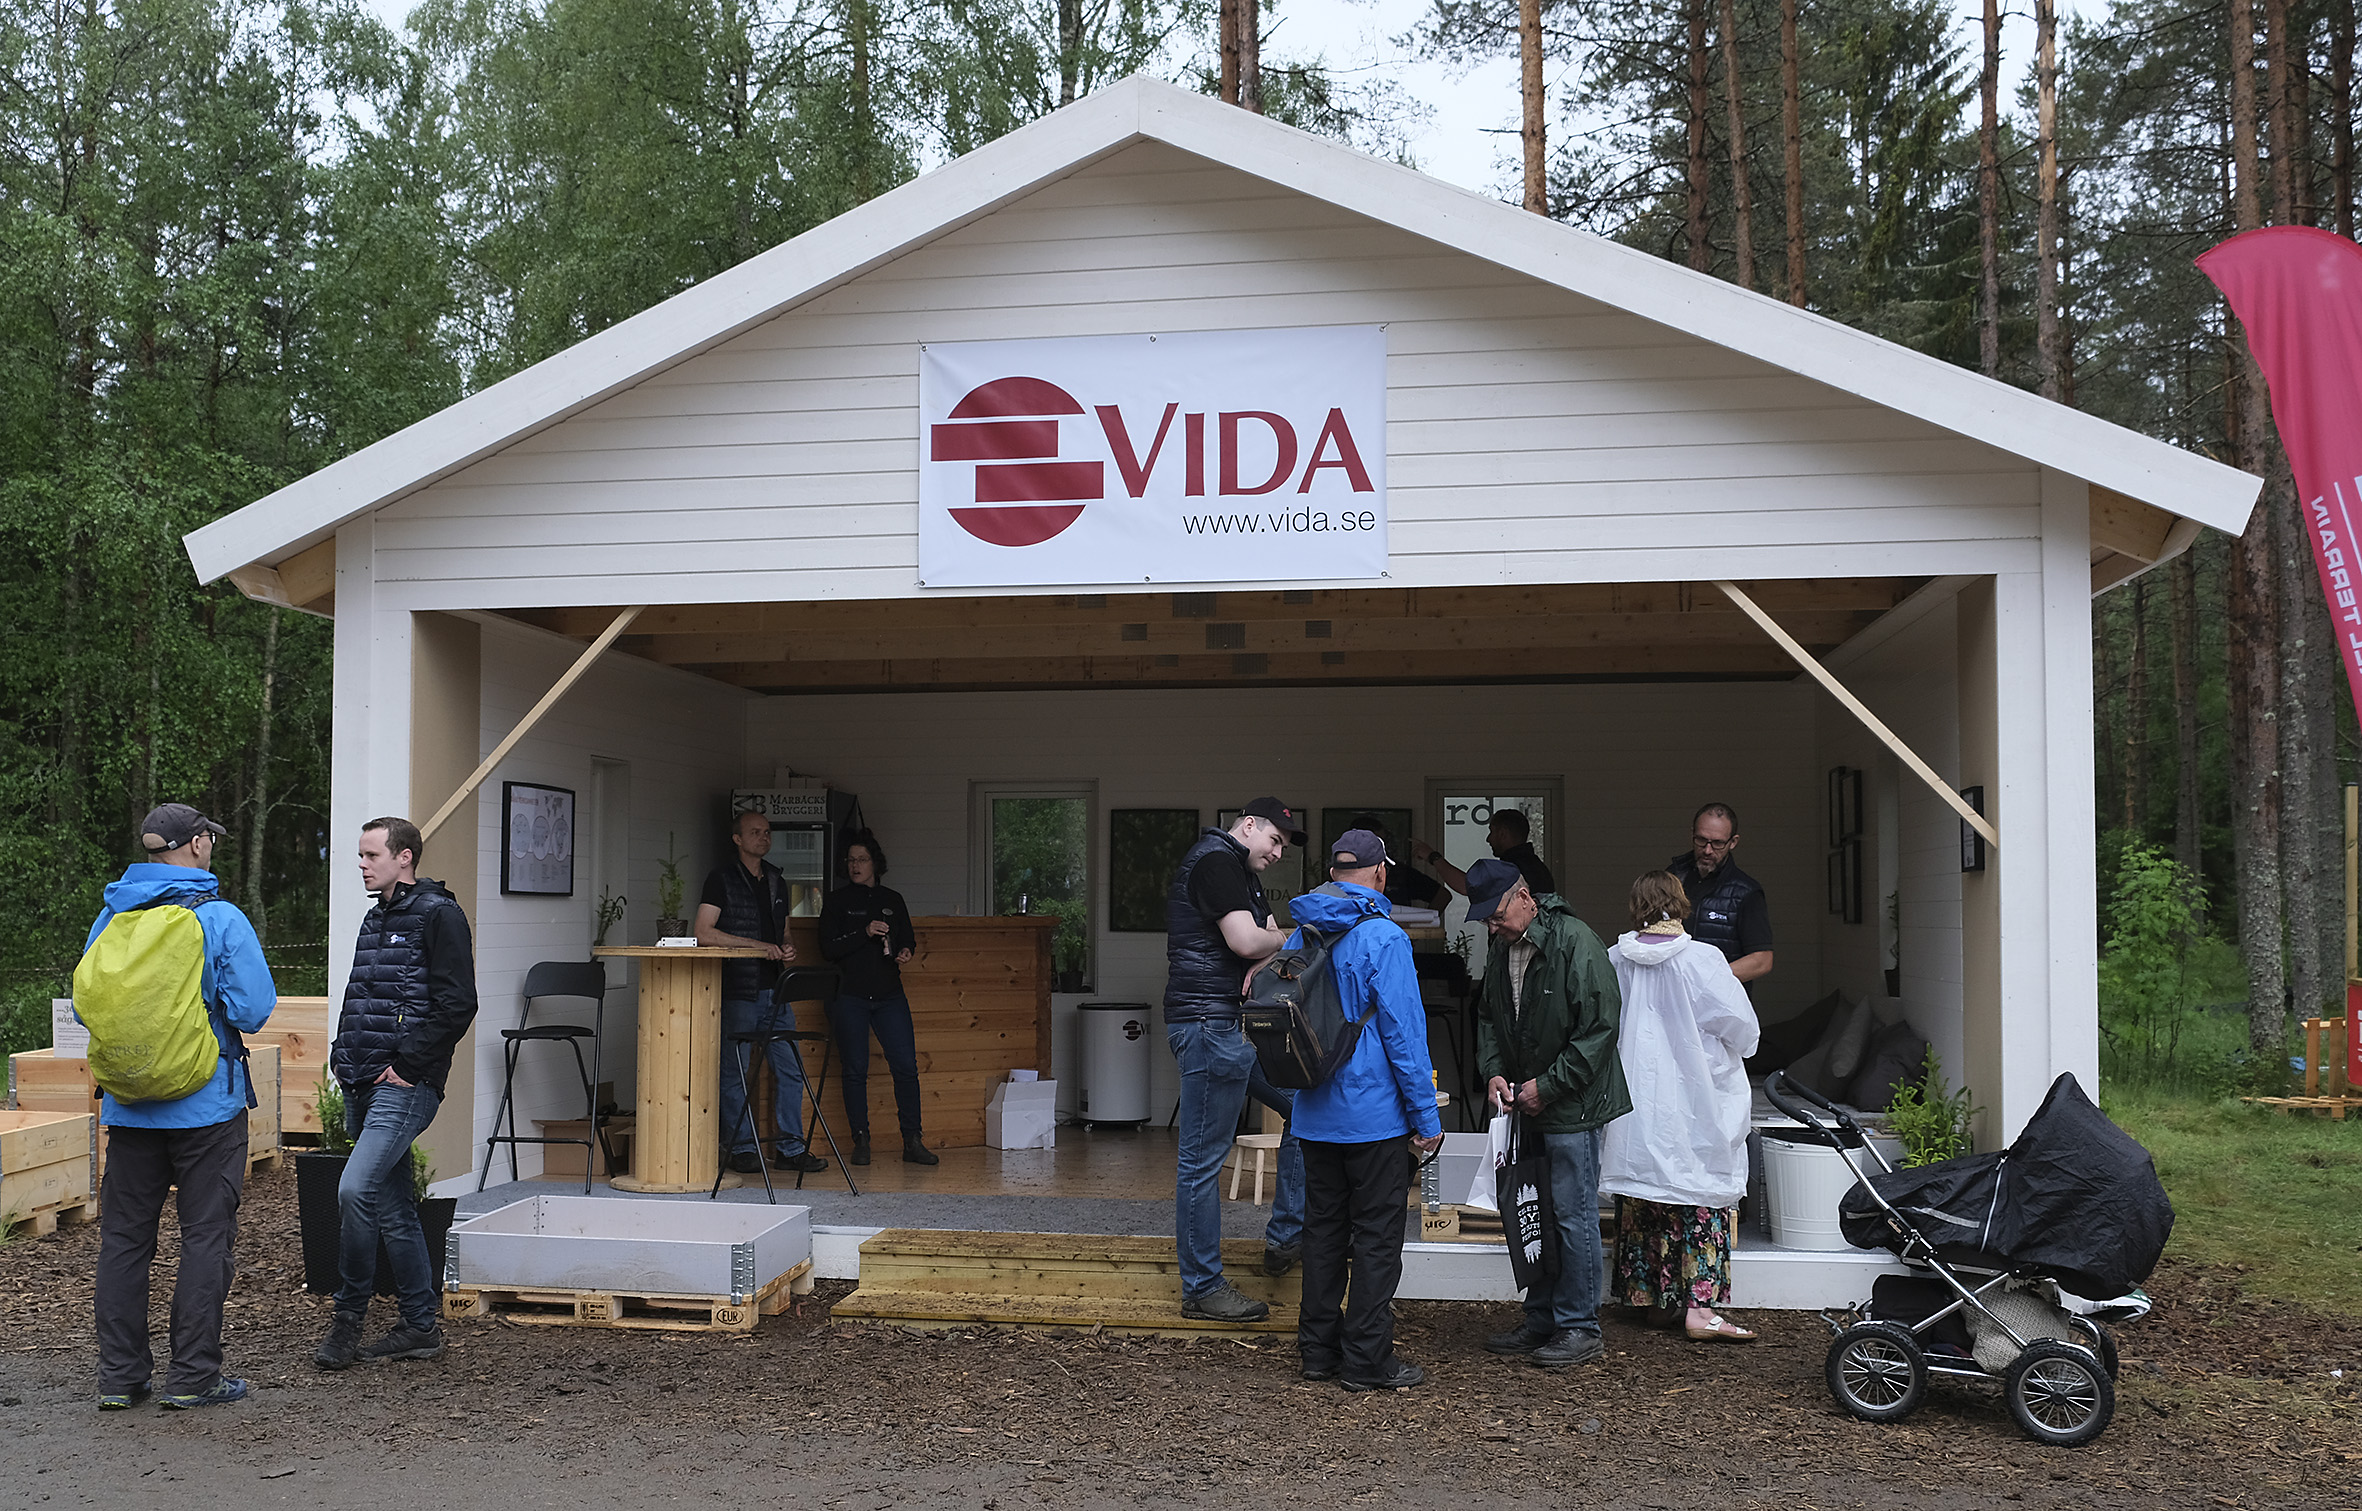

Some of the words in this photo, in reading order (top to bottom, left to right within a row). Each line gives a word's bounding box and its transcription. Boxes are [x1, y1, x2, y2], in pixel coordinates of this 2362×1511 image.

[1094, 402, 1375, 499] VIDA
[1183, 506, 1376, 535] www.vida.se
[722, 1311, 739, 1322] EUR
